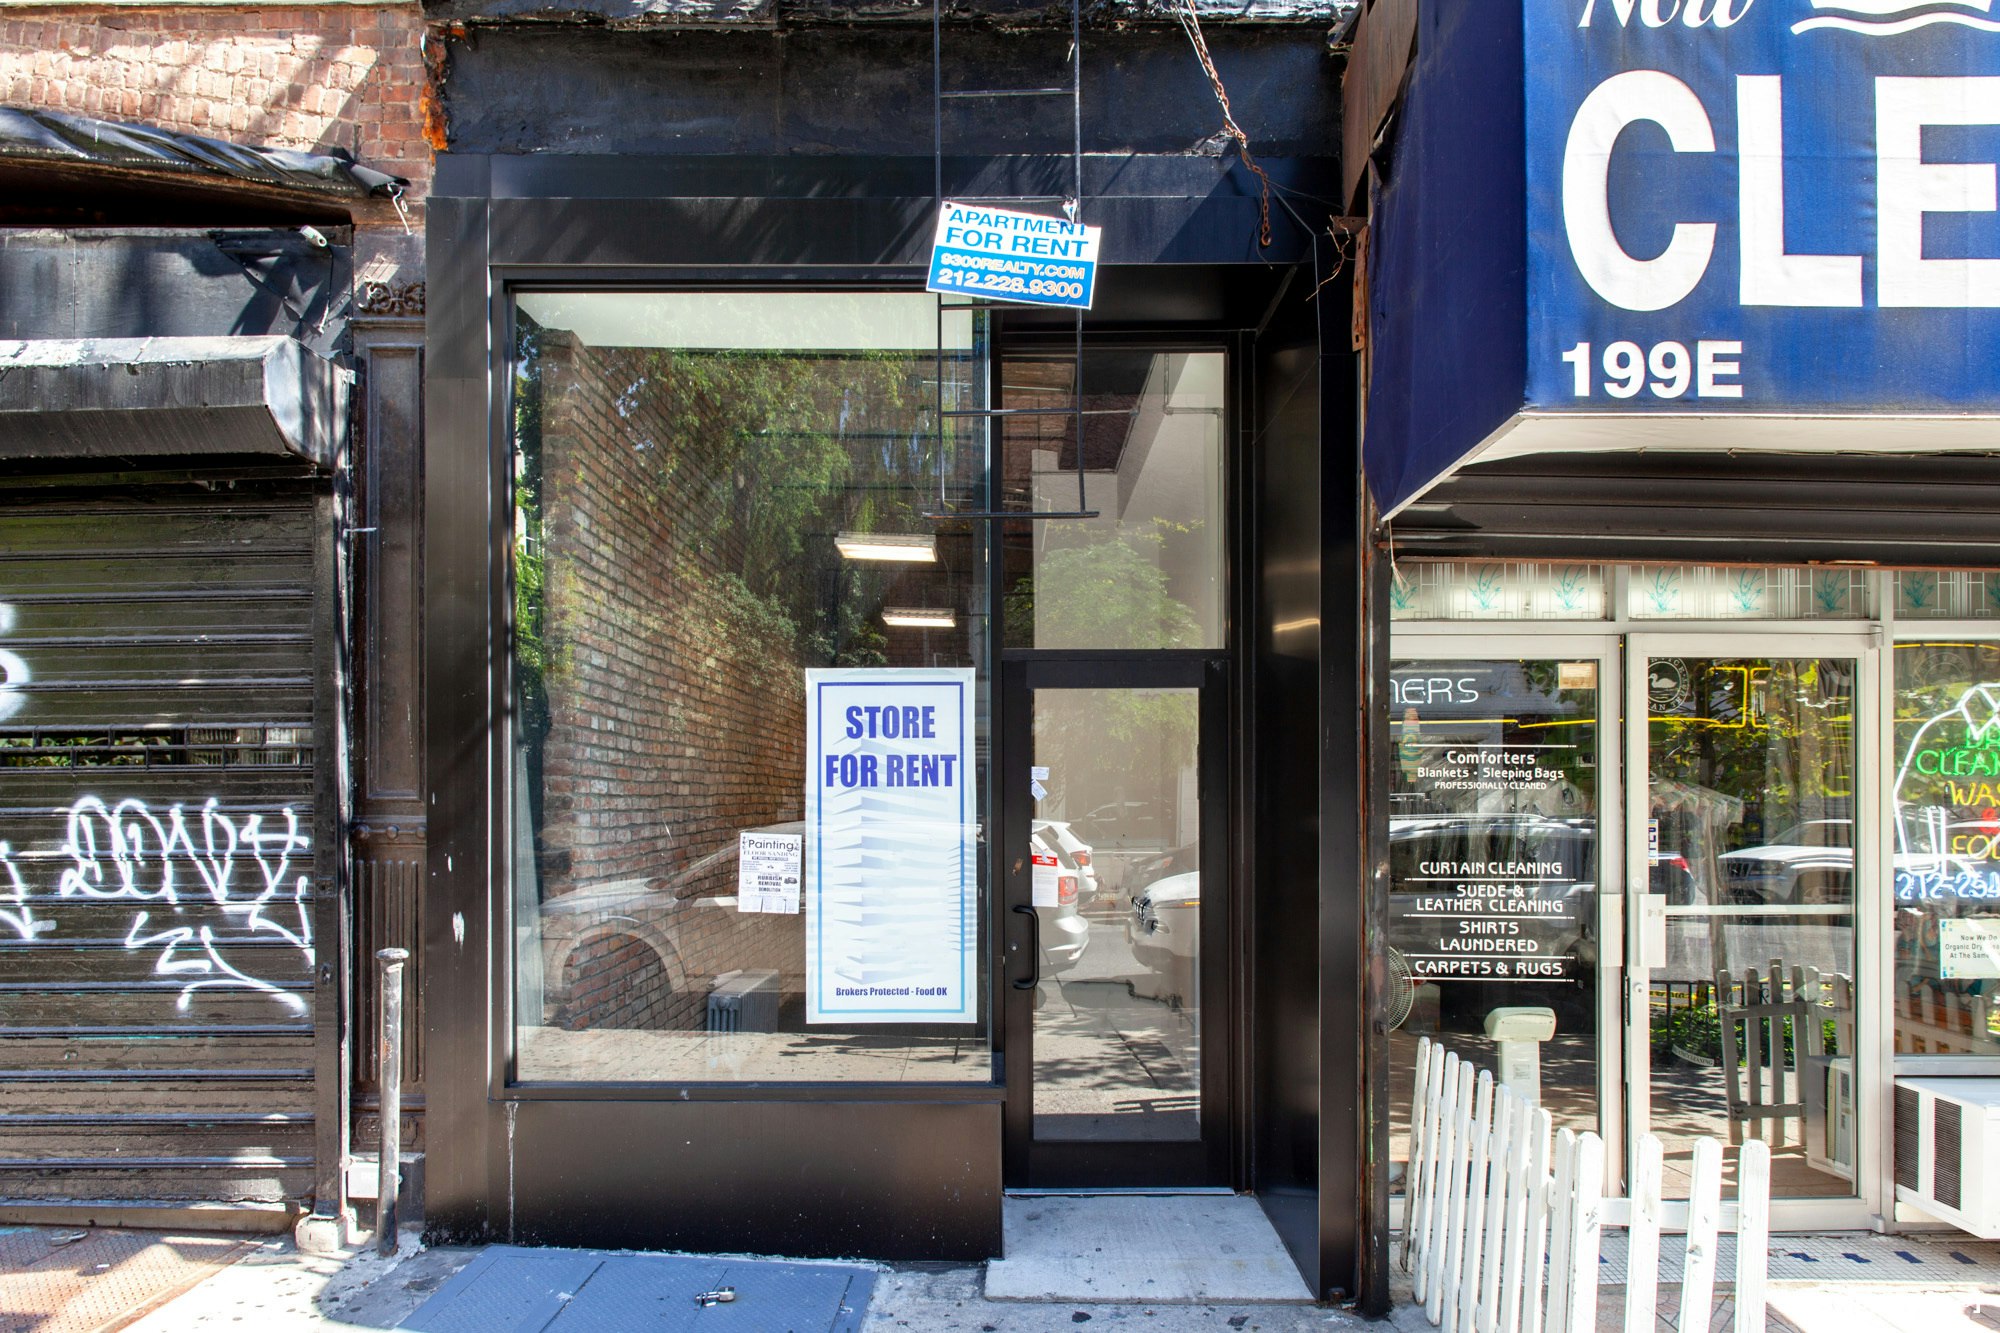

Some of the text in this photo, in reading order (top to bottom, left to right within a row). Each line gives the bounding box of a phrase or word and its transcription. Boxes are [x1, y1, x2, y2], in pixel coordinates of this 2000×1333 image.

[946, 227, 1089, 258] FOR RENT
[940, 252, 1086, 280] 9300REALTY.COM
[937, 269, 1083, 299] 212.228.9300
[1562, 340, 1744, 399] 199E
[845, 705, 936, 739] STORE
[1446, 750, 1536, 765] Comforters
[825, 754, 957, 787] FOR RENT
[1417, 767, 1564, 781] Blankets Sleeping Bags
[1434, 781, 1547, 790] PROFESSIONALLY CLEANED
[748, 839, 794, 852] Painting
[1419, 861, 1563, 875] CURTAIN CLEANING
[1456, 884, 1525, 898] SUEDE &
[1416, 899, 1563, 913] LEATHER CLEANING
[1459, 921, 1519, 934] SHIRTS
[1440, 938, 1538, 952] LAUNDERED
[1414, 960, 1563, 975] CARPETS & RUGS
[836, 987, 868, 996] Brokers
[869, 986, 910, 996] Protected
[915, 986, 935, 996] Food
[936, 987, 947, 996] OK
